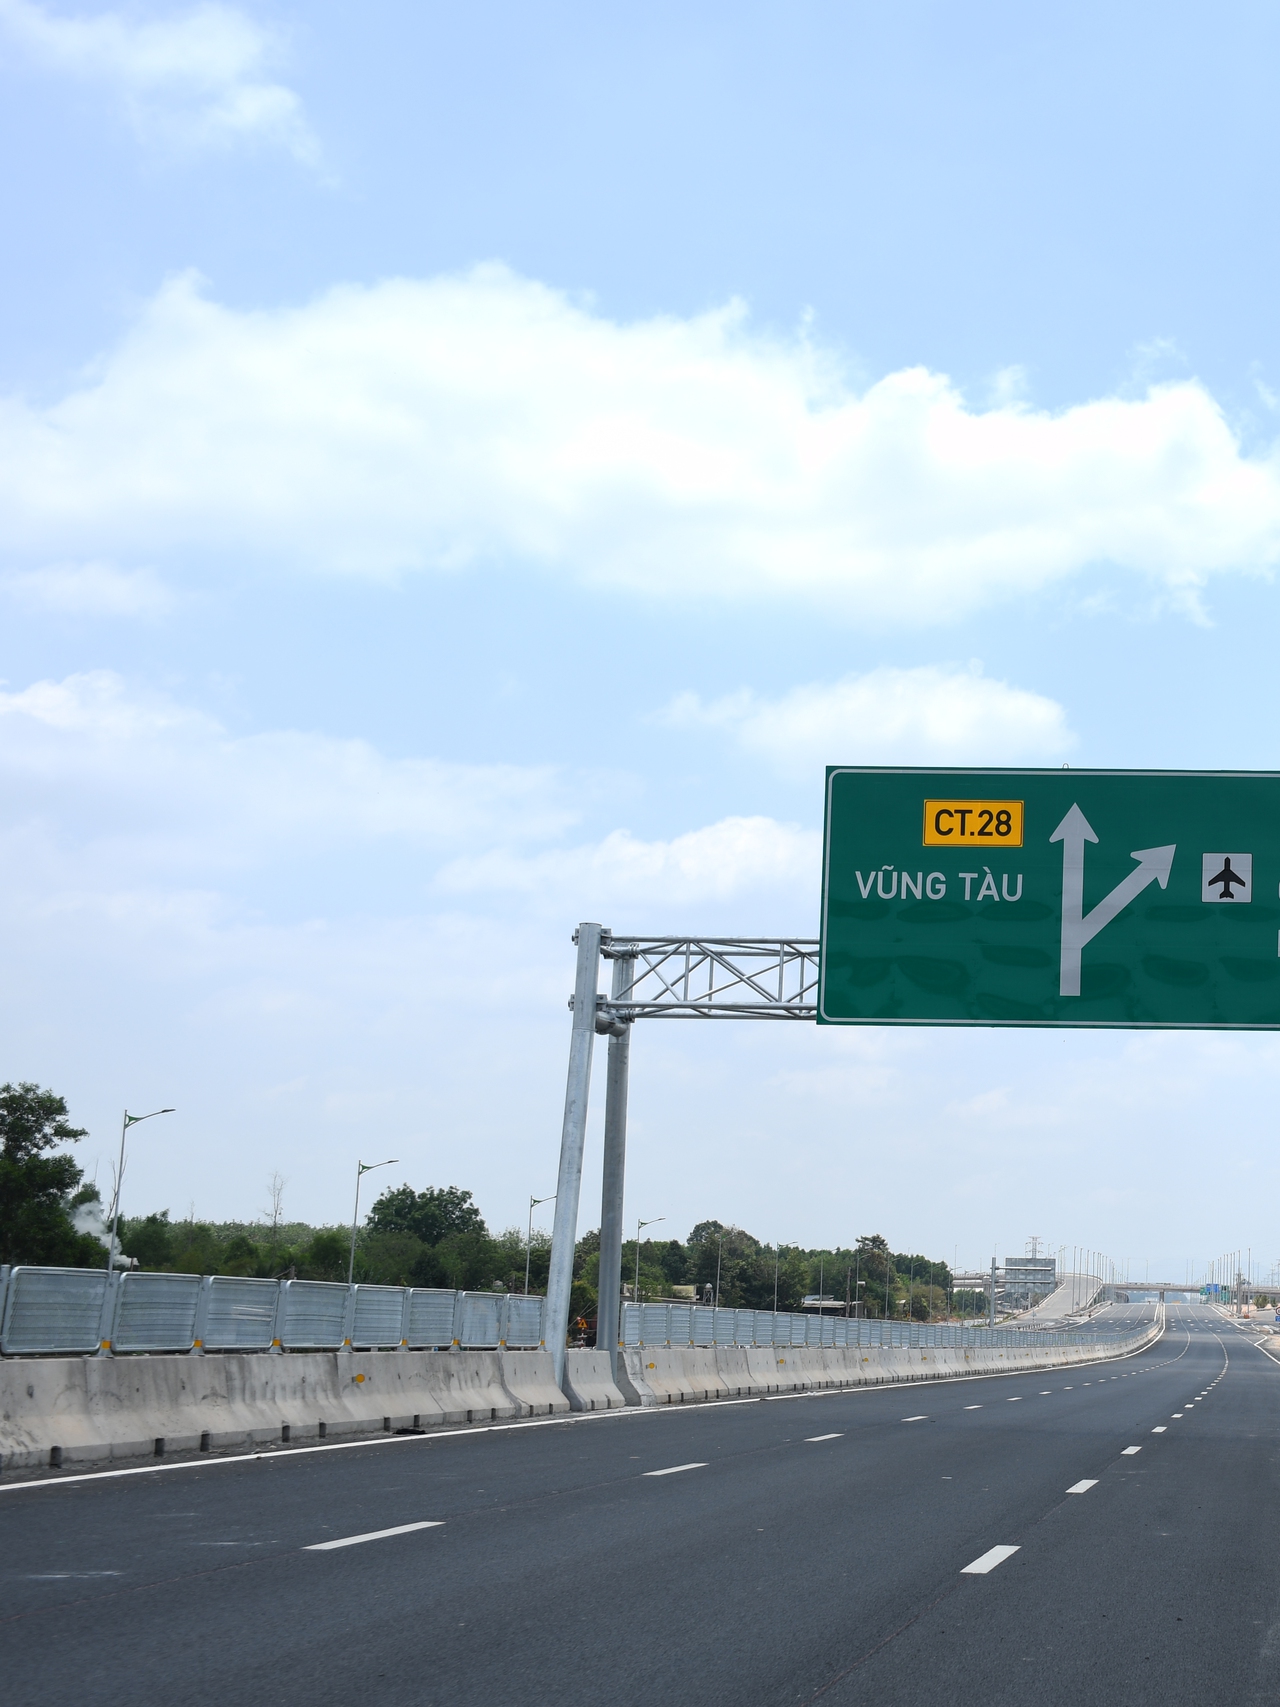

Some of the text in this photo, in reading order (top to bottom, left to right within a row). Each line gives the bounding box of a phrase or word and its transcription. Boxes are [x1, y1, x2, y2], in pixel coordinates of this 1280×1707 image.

[934, 808, 1012, 837] CT.28
[855, 865, 1023, 902] VŨNG TÀU
